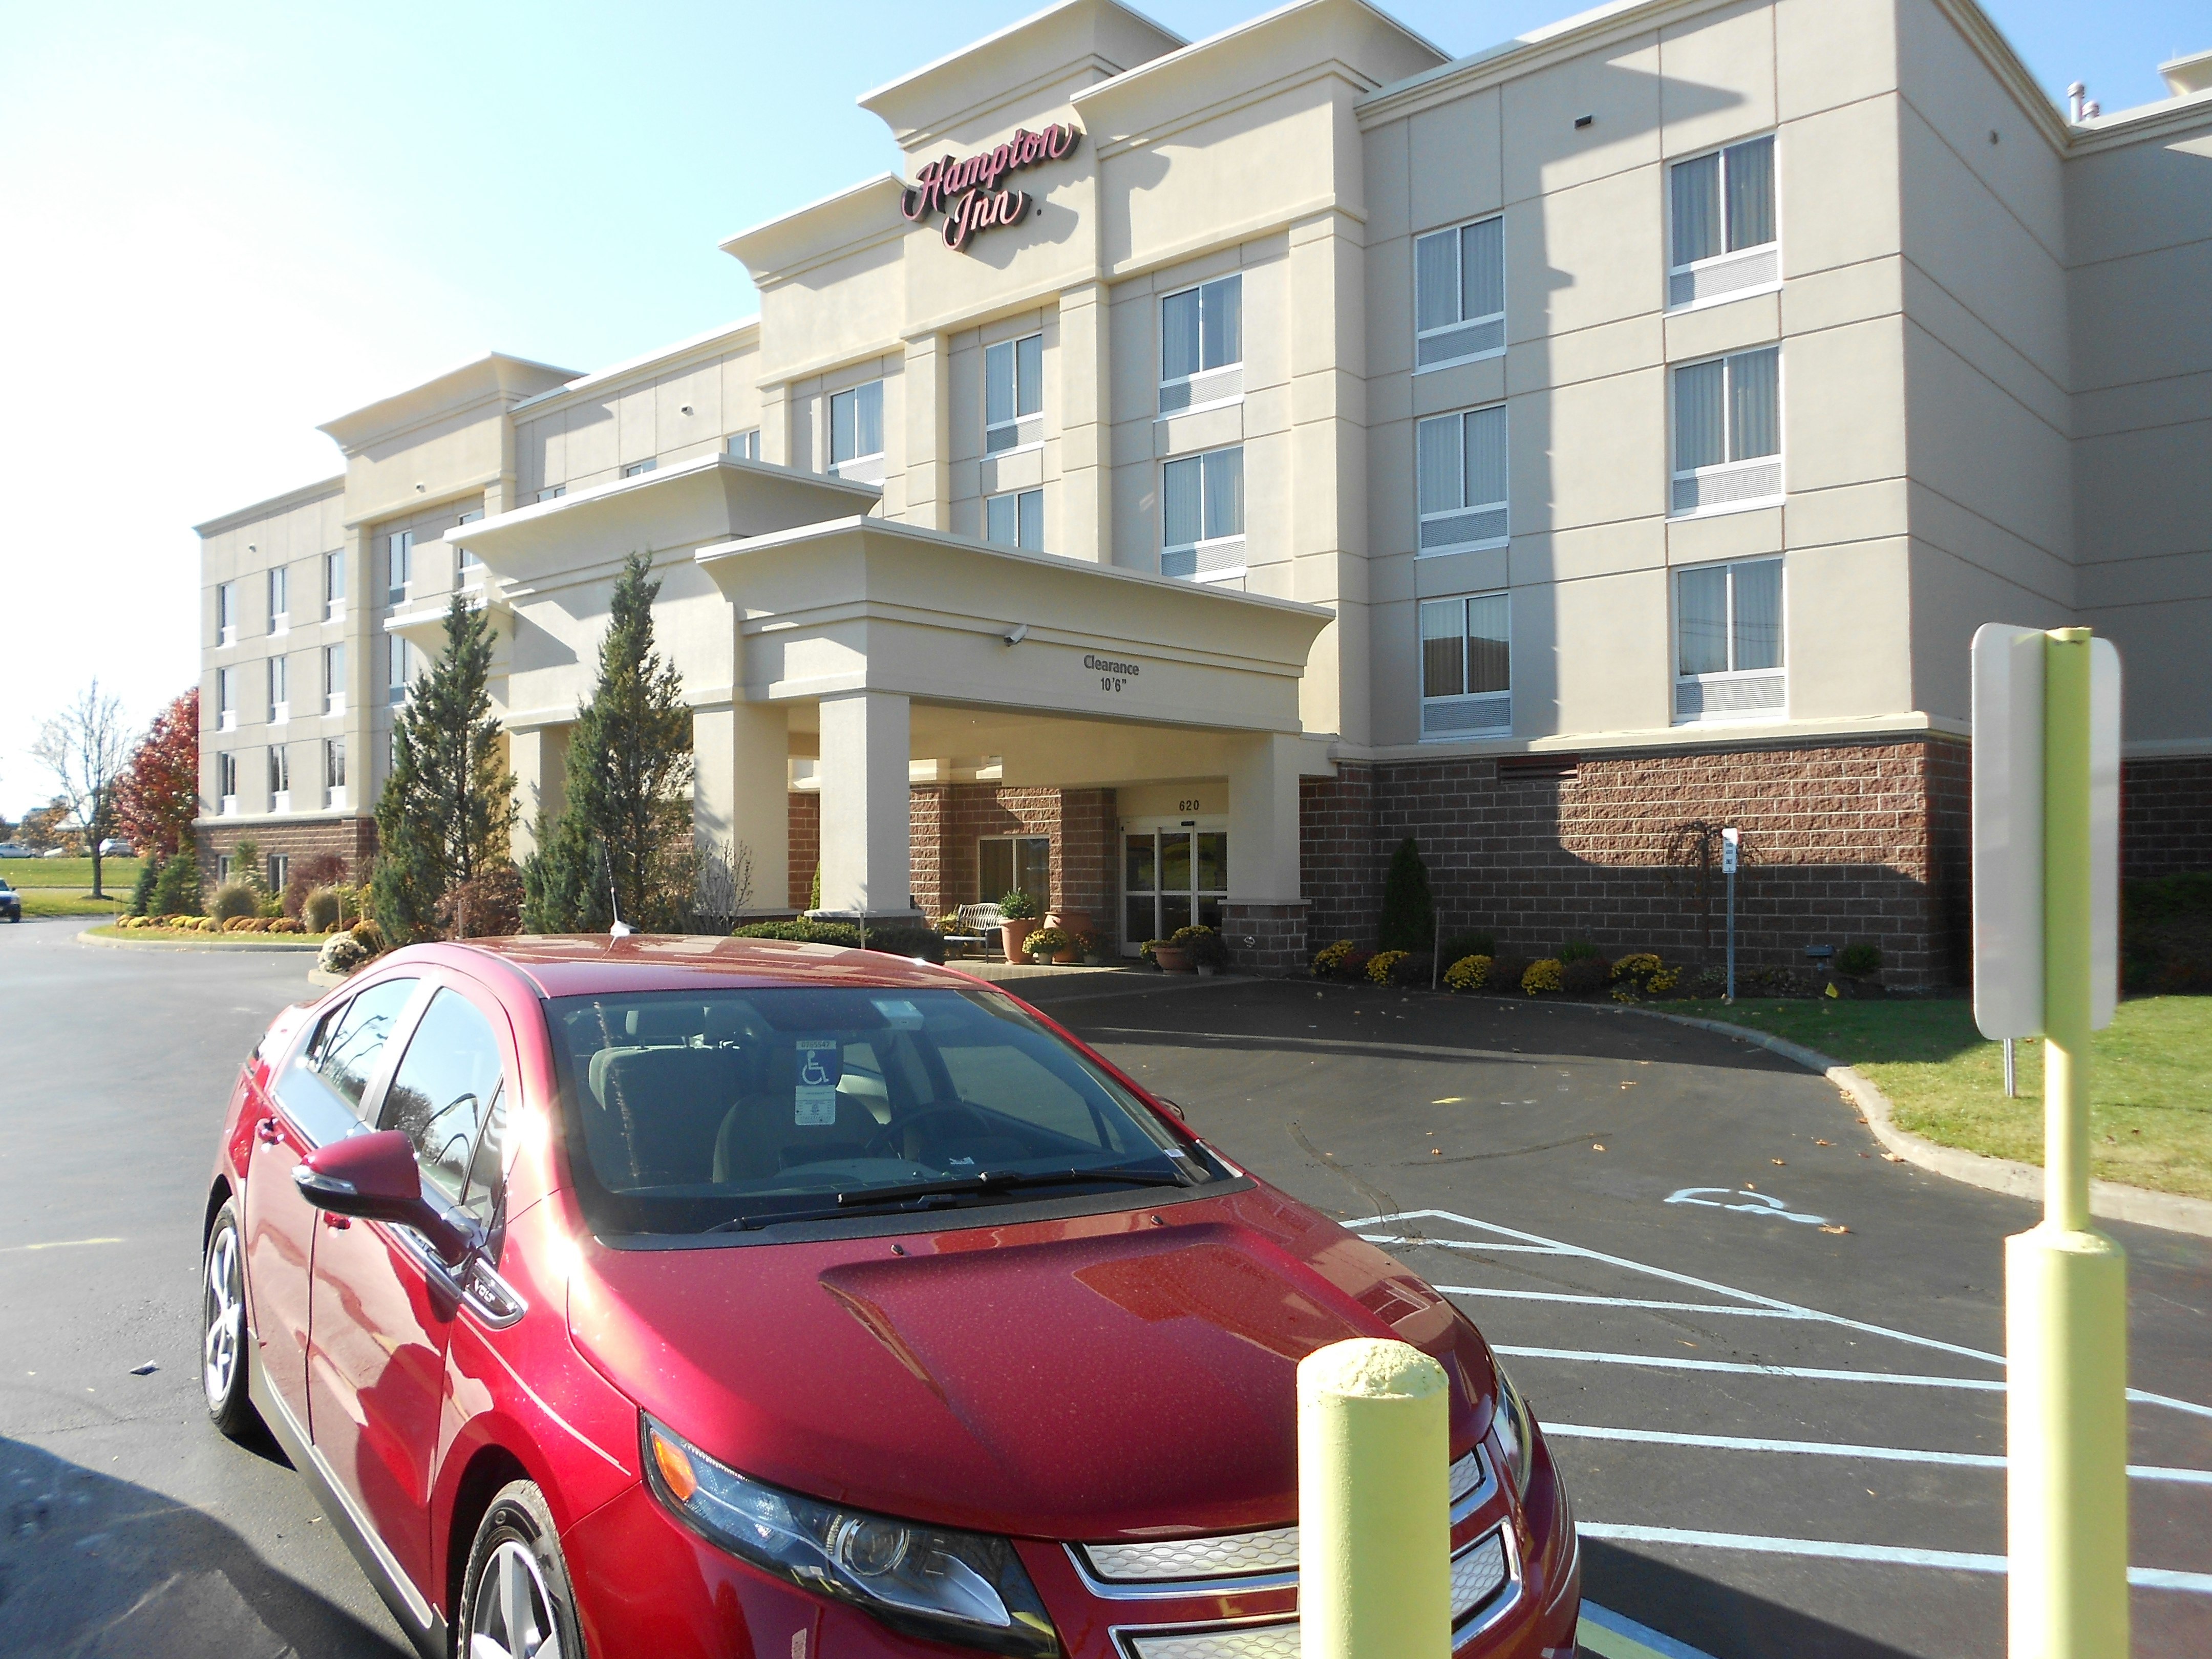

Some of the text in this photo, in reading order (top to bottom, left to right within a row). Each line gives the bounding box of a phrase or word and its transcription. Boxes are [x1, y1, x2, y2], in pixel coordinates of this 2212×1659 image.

[901, 123, 1081, 222] Hampton
[942, 187, 1032, 251] Inn
[1083, 655, 1139, 675] Clearance
[1179, 800, 1199, 811] 620
[475, 1279, 496, 1302] VOLT
